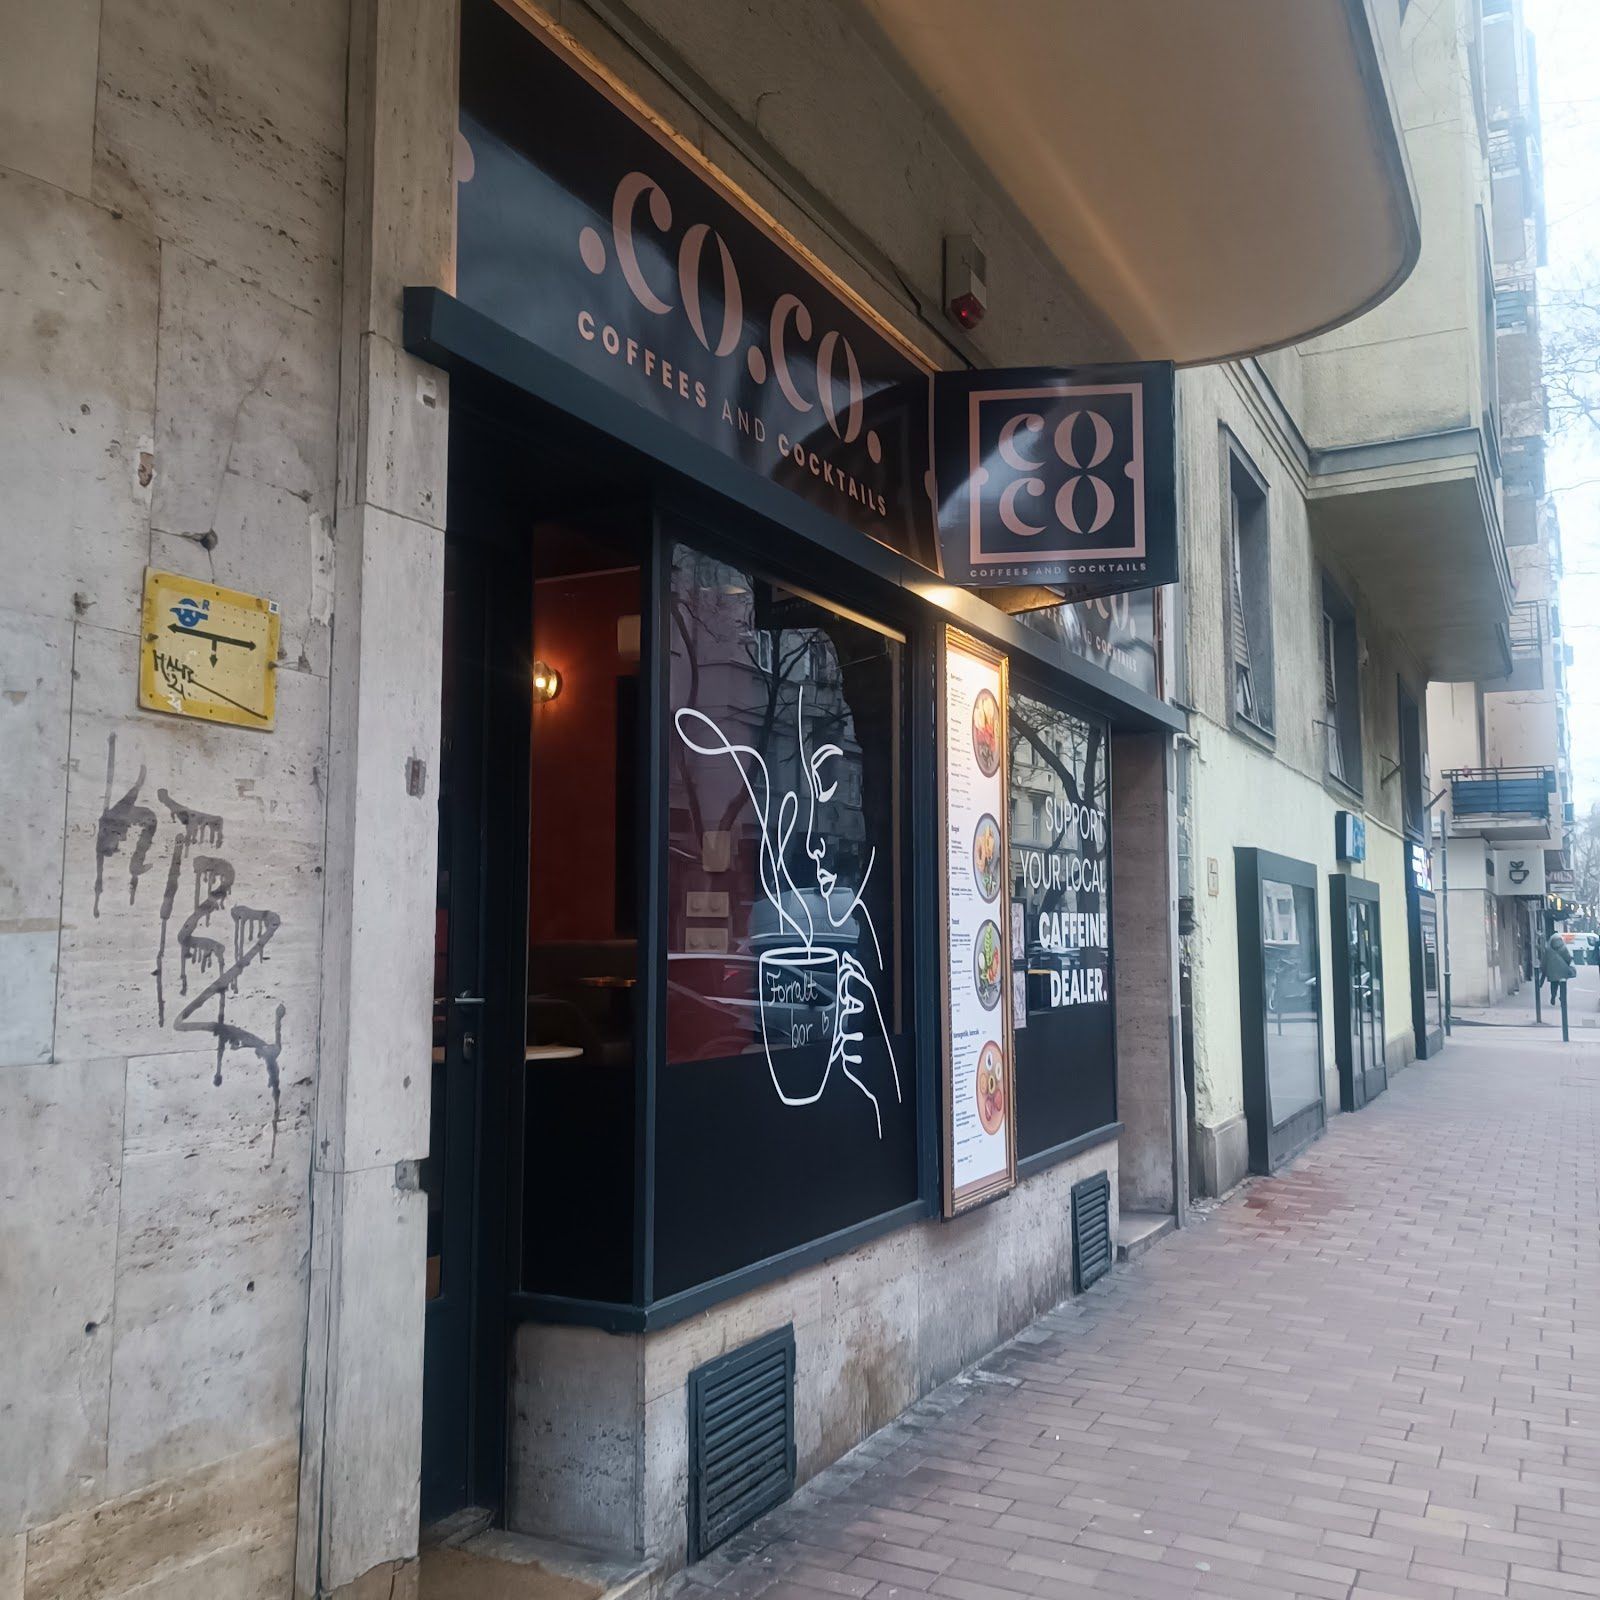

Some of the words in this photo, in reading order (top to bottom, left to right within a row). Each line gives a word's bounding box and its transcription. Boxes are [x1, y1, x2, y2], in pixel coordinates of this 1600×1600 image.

[577, 310, 707, 408] COFFEES
[721, 402, 766, 443] AND
[777, 433, 887, 516] COCKTAILS
[998, 410, 1114, 472] CO
[998, 474, 1115, 536] CO
[969, 567, 1029, 578] COFFEES
[1035, 566, 1062, 575] AND
[1068, 562, 1147, 574] COCKTAILS
[1045, 795, 1104, 844] SUPPORT
[1019, 850, 1062, 891] YOUR
[1065, 856, 1106, 893] LOCAL
[1038, 911, 1108, 949] CAFFEINE
[766, 969, 818, 1007] Forralt
[1050, 968, 1108, 1008] DEALER.
[790, 1007, 813, 1049] bor
